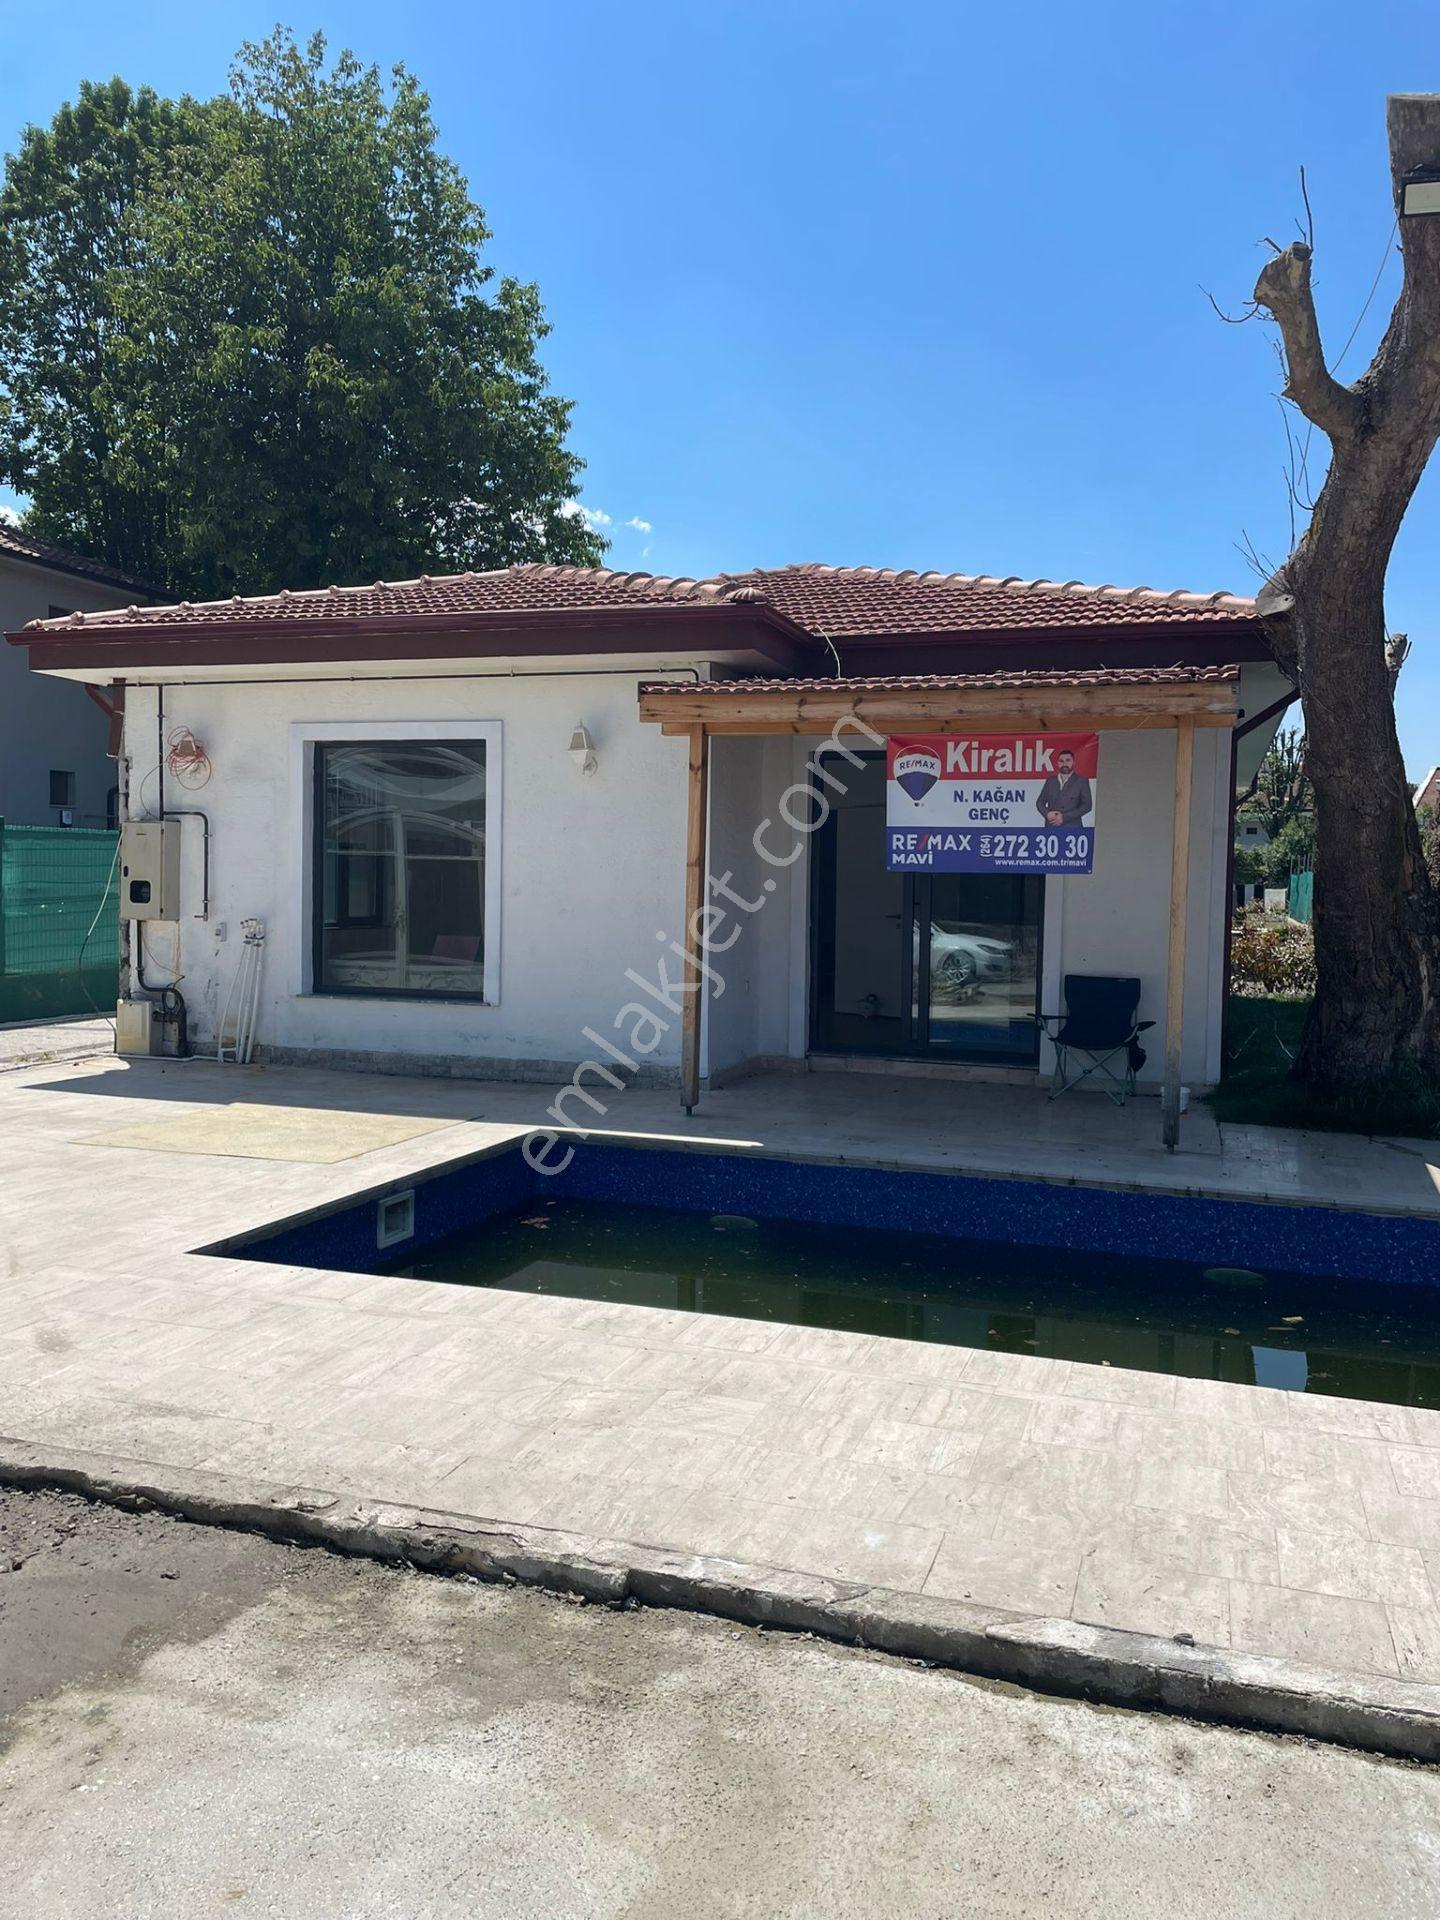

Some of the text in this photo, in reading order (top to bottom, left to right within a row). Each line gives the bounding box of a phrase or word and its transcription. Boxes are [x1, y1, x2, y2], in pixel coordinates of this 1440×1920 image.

[899, 759, 936, 771] RE/MAX
[946, 740, 1055, 773] Kiralık
[953, 786, 1025, 803] N. KAĞAN
[968, 808, 1010, 824] GENÇ
[892, 834, 972, 851] RE/MAX
[980, 834, 1088, 858] (264) 272 30 30
[892, 851, 933, 865] MAVİ
